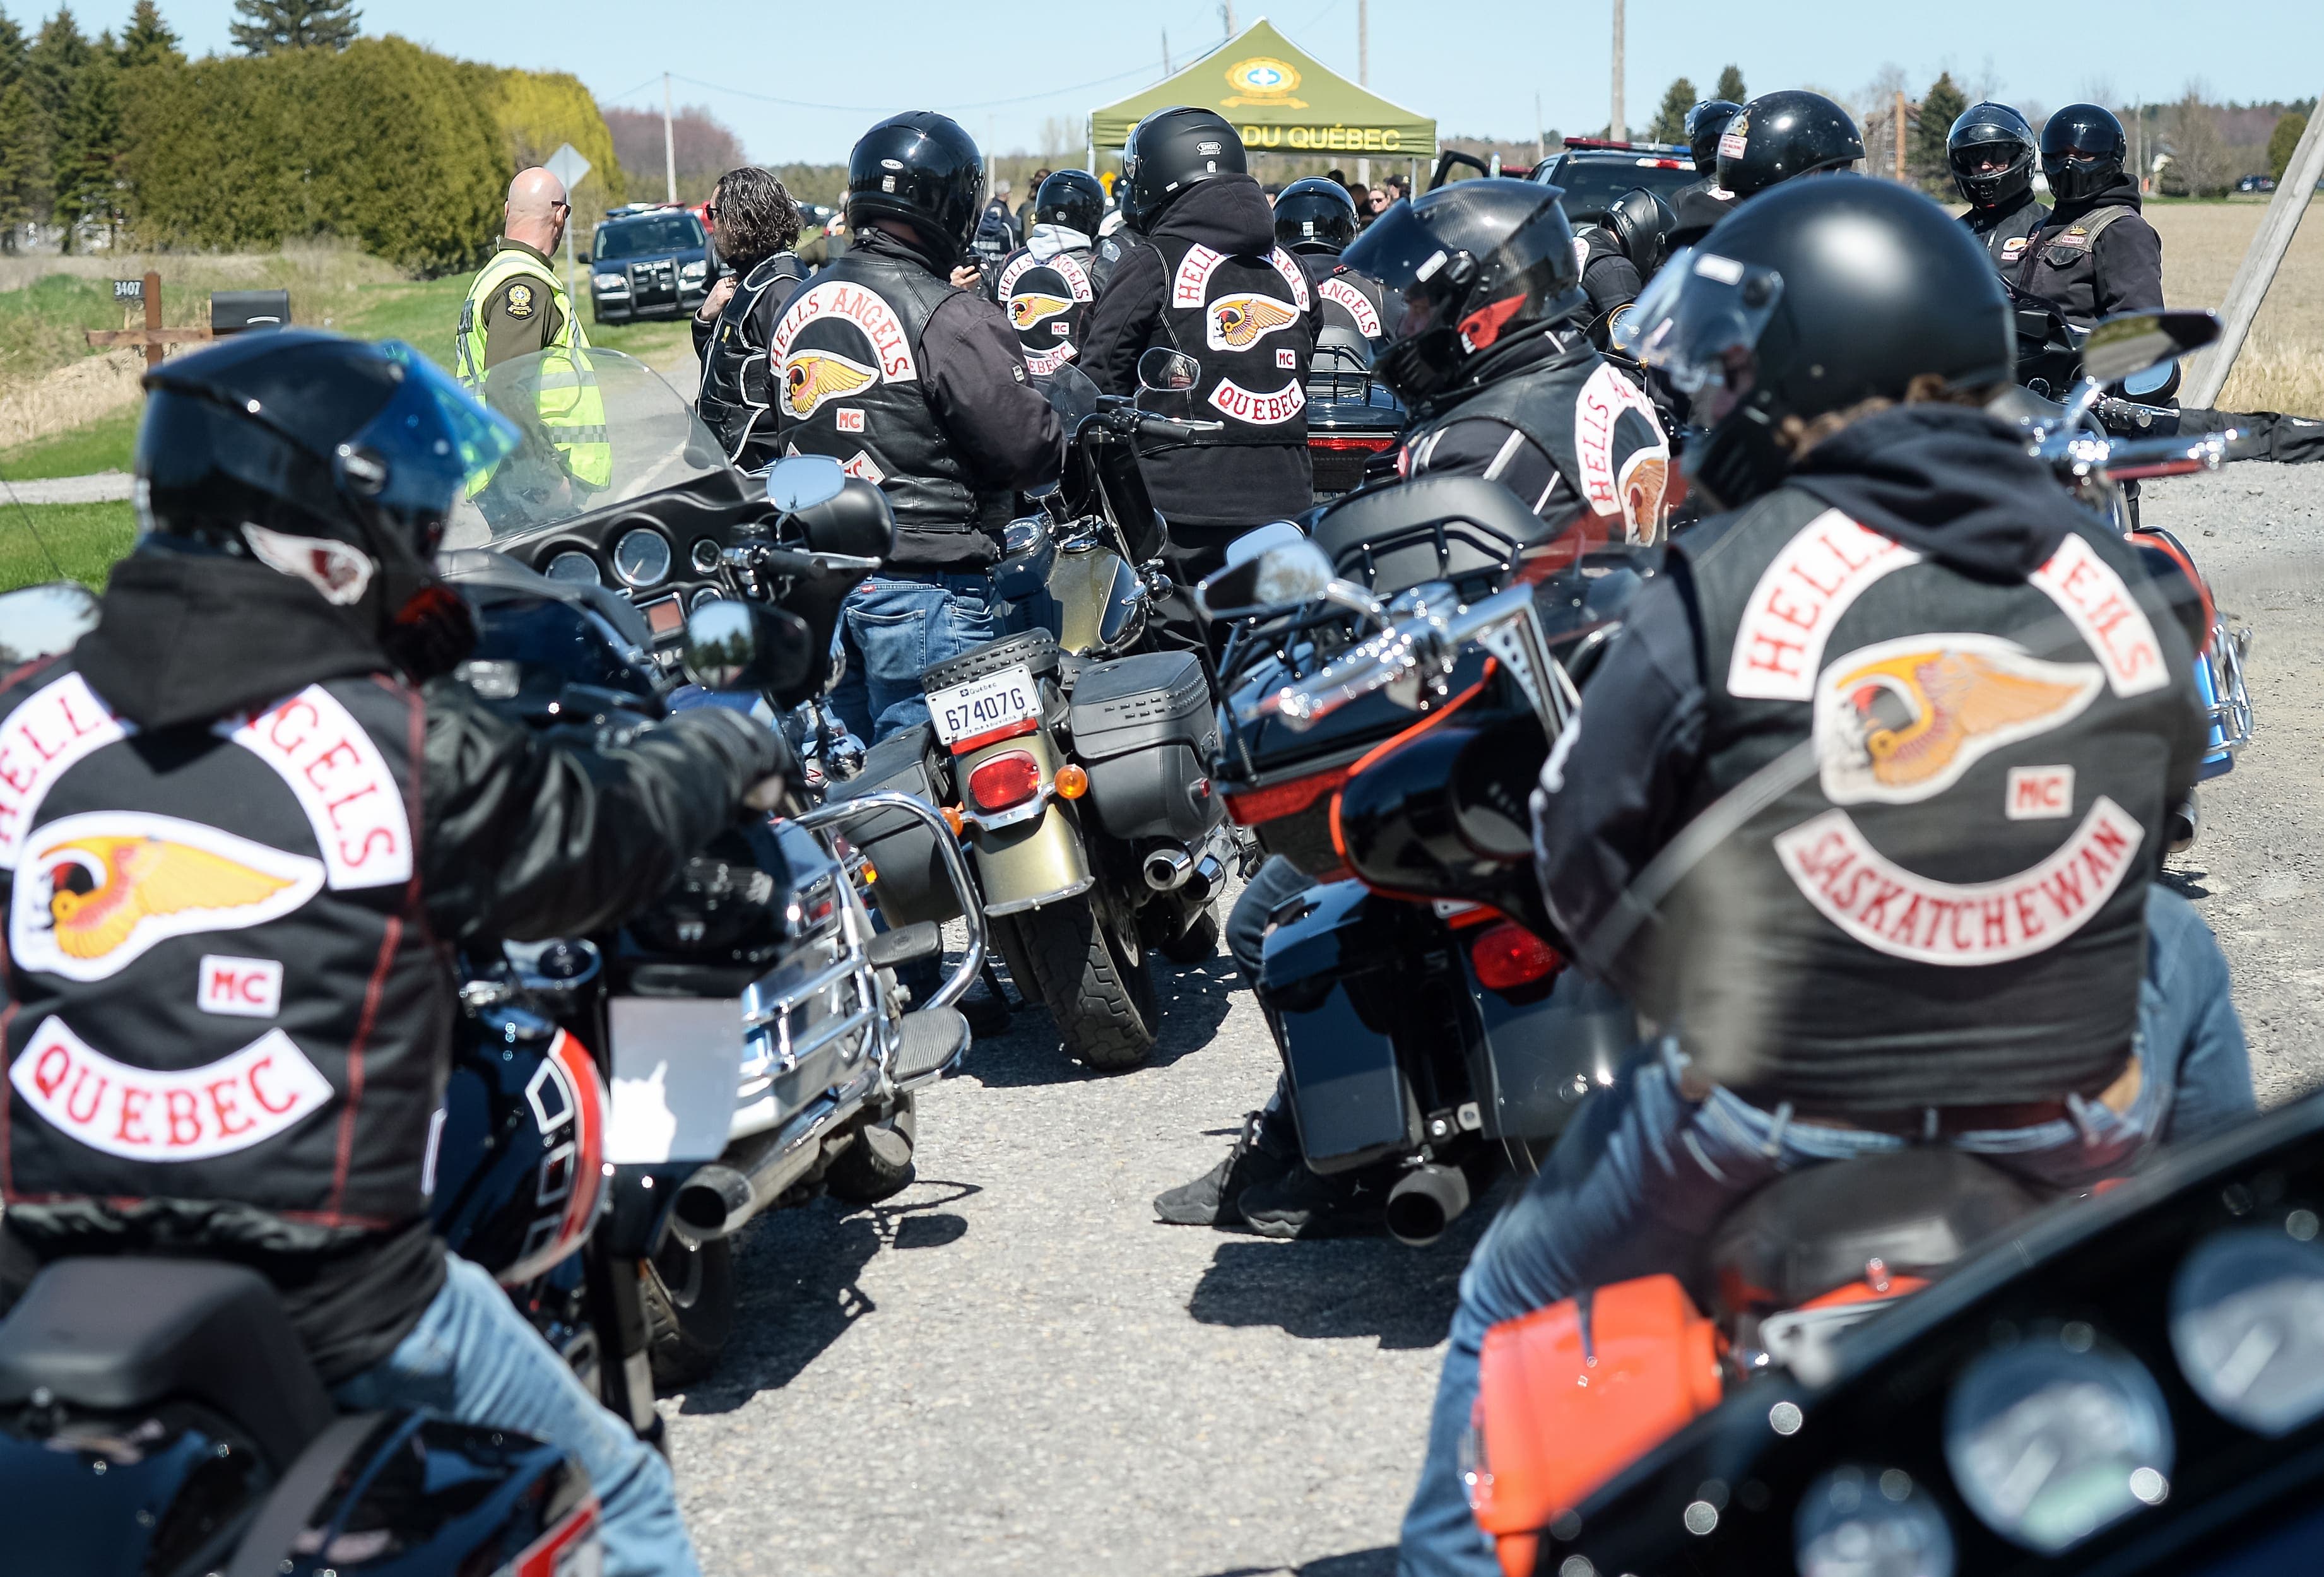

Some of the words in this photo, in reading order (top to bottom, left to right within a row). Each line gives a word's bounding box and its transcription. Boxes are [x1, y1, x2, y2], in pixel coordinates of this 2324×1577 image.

[1242, 125, 1281, 146] DU
[1287, 123, 1401, 151] QUÉBEC
[114, 281, 141, 296] 3407
[1000, 255, 1033, 297] HELLS
[1052, 255, 1088, 300] NGELS
[1178, 247, 1219, 301] HELL
[772, 292, 820, 369] HELLS
[829, 288, 909, 377] ANGELS
[1054, 324, 1066, 333] MC
[1279, 353, 1293, 366] MC
[839, 412, 861, 429] MC
[1218, 387, 1301, 421] QUEBEC
[1583, 394, 1614, 503] HELLS
[945, 688, 1025, 731] 67407G
[256, 697, 396, 869] GELS
[2016, 776, 2063, 808] MC
[1798, 819, 2128, 952] SASKATCHEWAN
[211, 970, 268, 1004] MC
[33, 1043, 299, 1148] QUEBEC
